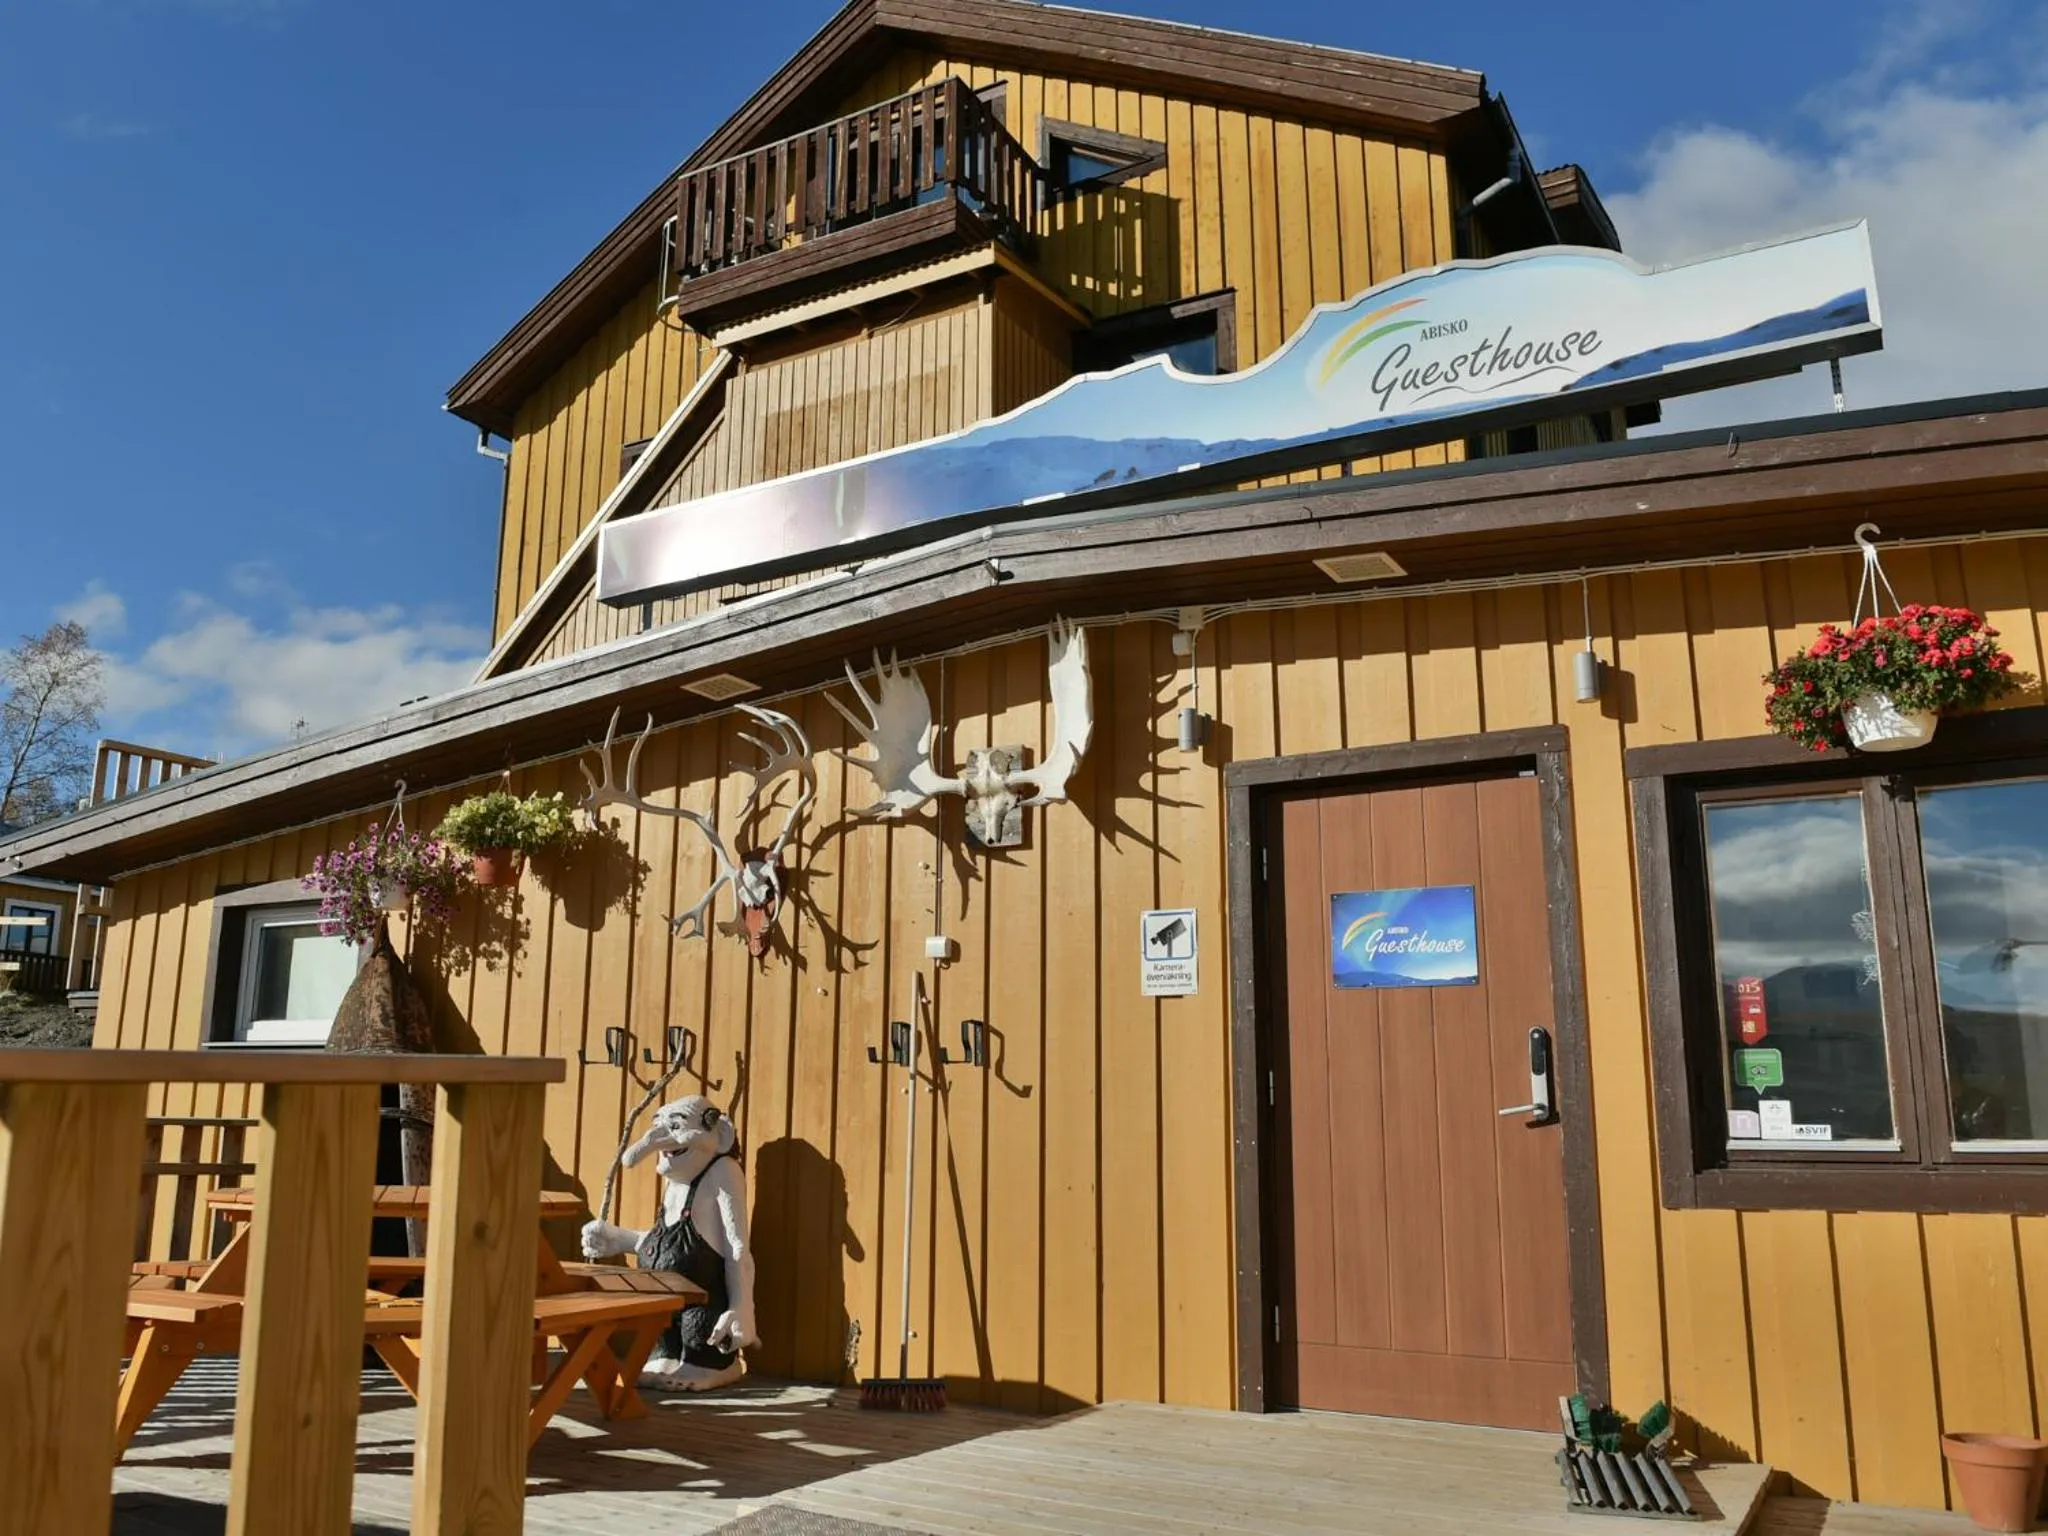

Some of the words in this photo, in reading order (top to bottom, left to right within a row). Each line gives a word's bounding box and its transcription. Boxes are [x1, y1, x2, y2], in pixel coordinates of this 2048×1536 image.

[1420, 319, 1469, 342] ABISKO
[1371, 326, 1603, 412] Guesthouse
[1365, 928, 1467, 961] Guesthouse
